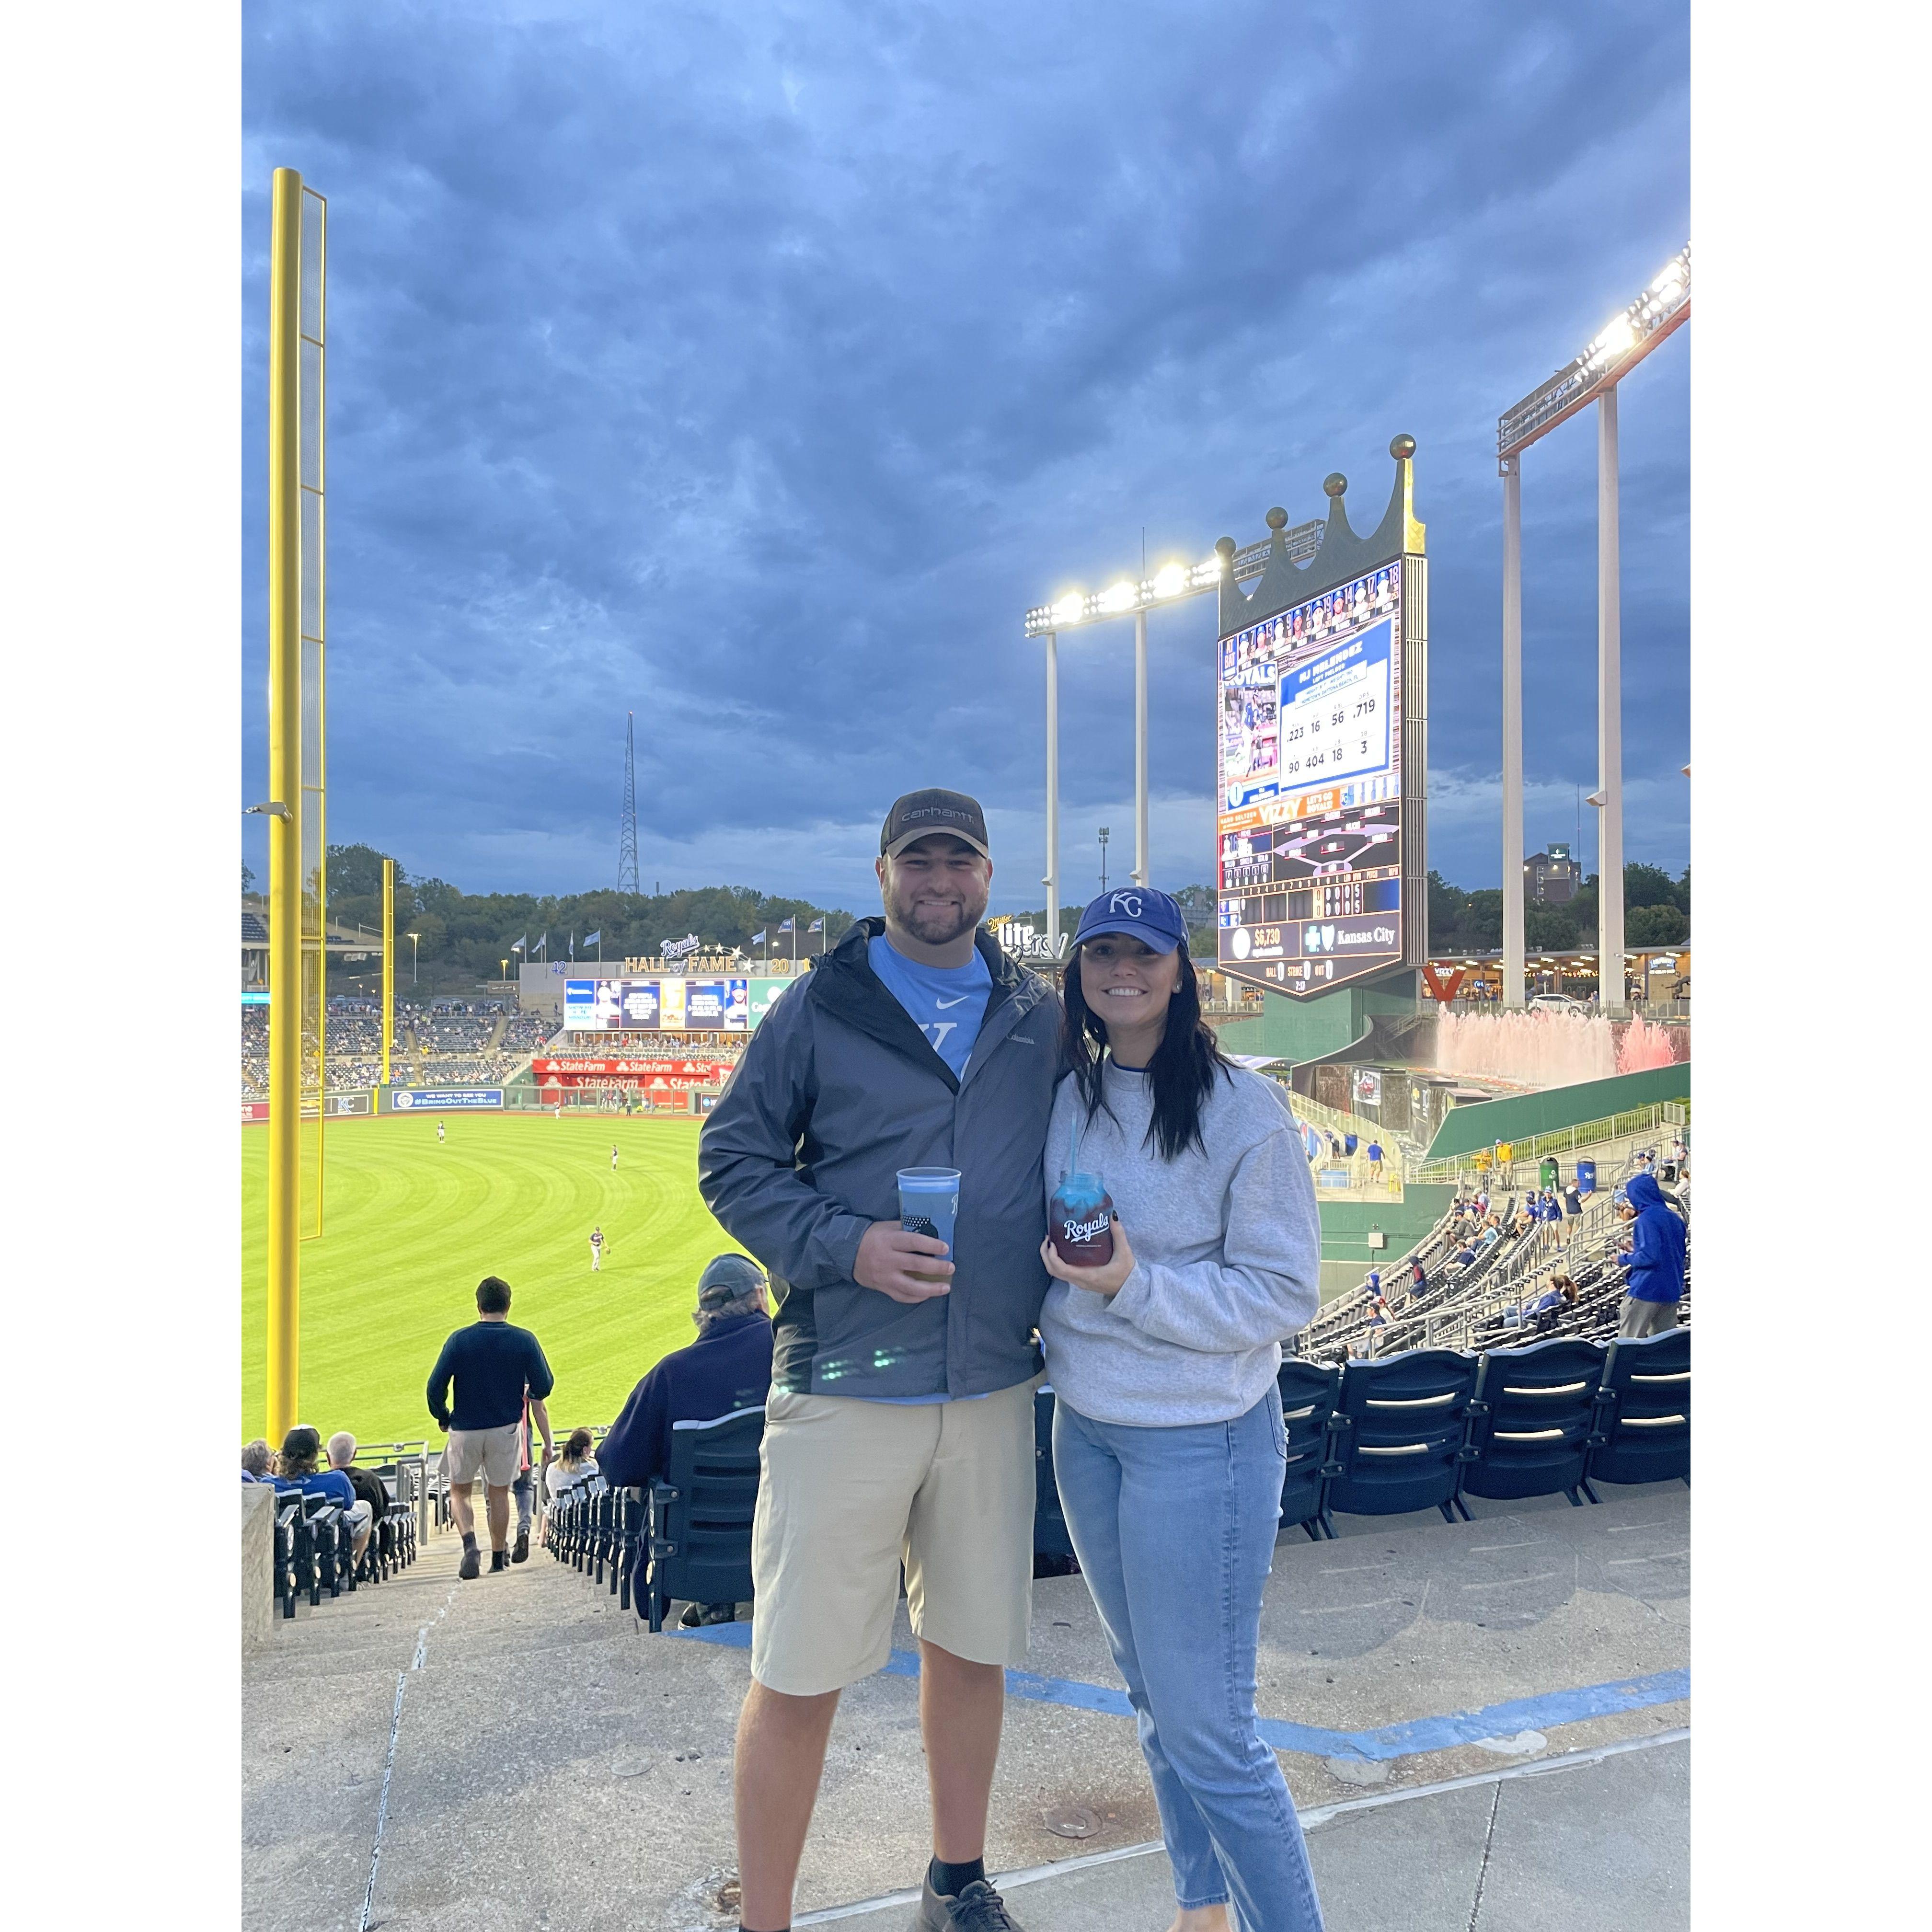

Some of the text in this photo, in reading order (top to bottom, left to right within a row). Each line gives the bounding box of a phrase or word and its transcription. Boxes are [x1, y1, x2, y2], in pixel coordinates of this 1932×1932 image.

[1389, 565, 1398, 585] 18
[1367, 576, 1375, 594] 17
[1345, 586, 1353, 604] 14
[1306, 604, 1311, 621] 2
[1323, 596, 1331, 613] 19
[1286, 614, 1291, 629] 9
[1250, 630, 1255, 645] 7
[1265, 622, 1273, 639] 13
[1226, 638, 1234, 654] AT
[1225, 652, 1235, 669] BAT
[1313, 641, 1363, 677] MELENDEZ
[1322, 685, 1338, 695] DAYTONA
[1287, 699, 1375, 742] .223 16 56 .719
[1289, 740, 1367, 773] 90 404 18 3
[1307, 792, 1333, 805] LET'S GO
[1307, 800, 1333, 814] ROYALS!
[901, 807, 973, 823] carhartt
[1258, 797, 1303, 825] VIZZY
[1366, 870, 1378, 879] PITCH
[1317, 890, 1320, 901] 0
[1325, 887, 1331, 901] 0
[1334, 886, 1340, 900] 0
[1345, 885, 1350, 898] 0
[1355, 884, 1360, 897] 5
[1109, 892, 1142, 918] KC
[1317, 906, 1320, 916] 0
[1325, 903, 1331, 916] 0
[1334, 902, 1340, 915] 0
[1345, 901, 1350, 914] 0
[1355, 900, 1360, 913] 5
[987, 915, 1013, 932] Miller
[1254, 928, 1280, 947] $6,730
[1337, 927, 1395, 945] Kansas City
[660, 933, 700, 958] Royals
[551, 961, 567, 975] 42
[625, 955, 737, 976] HALL of FAME
[770, 958, 789, 974] 20
[802, 958, 810, 972] 1
[1265, 959, 1333, 981] BALL 0 STRIKE 0 OUT 0
[1006, 1033, 1035, 1045] Columbia
[337, 1097, 355, 1114] KC
[1064, 1213, 1109, 1243] Royals
